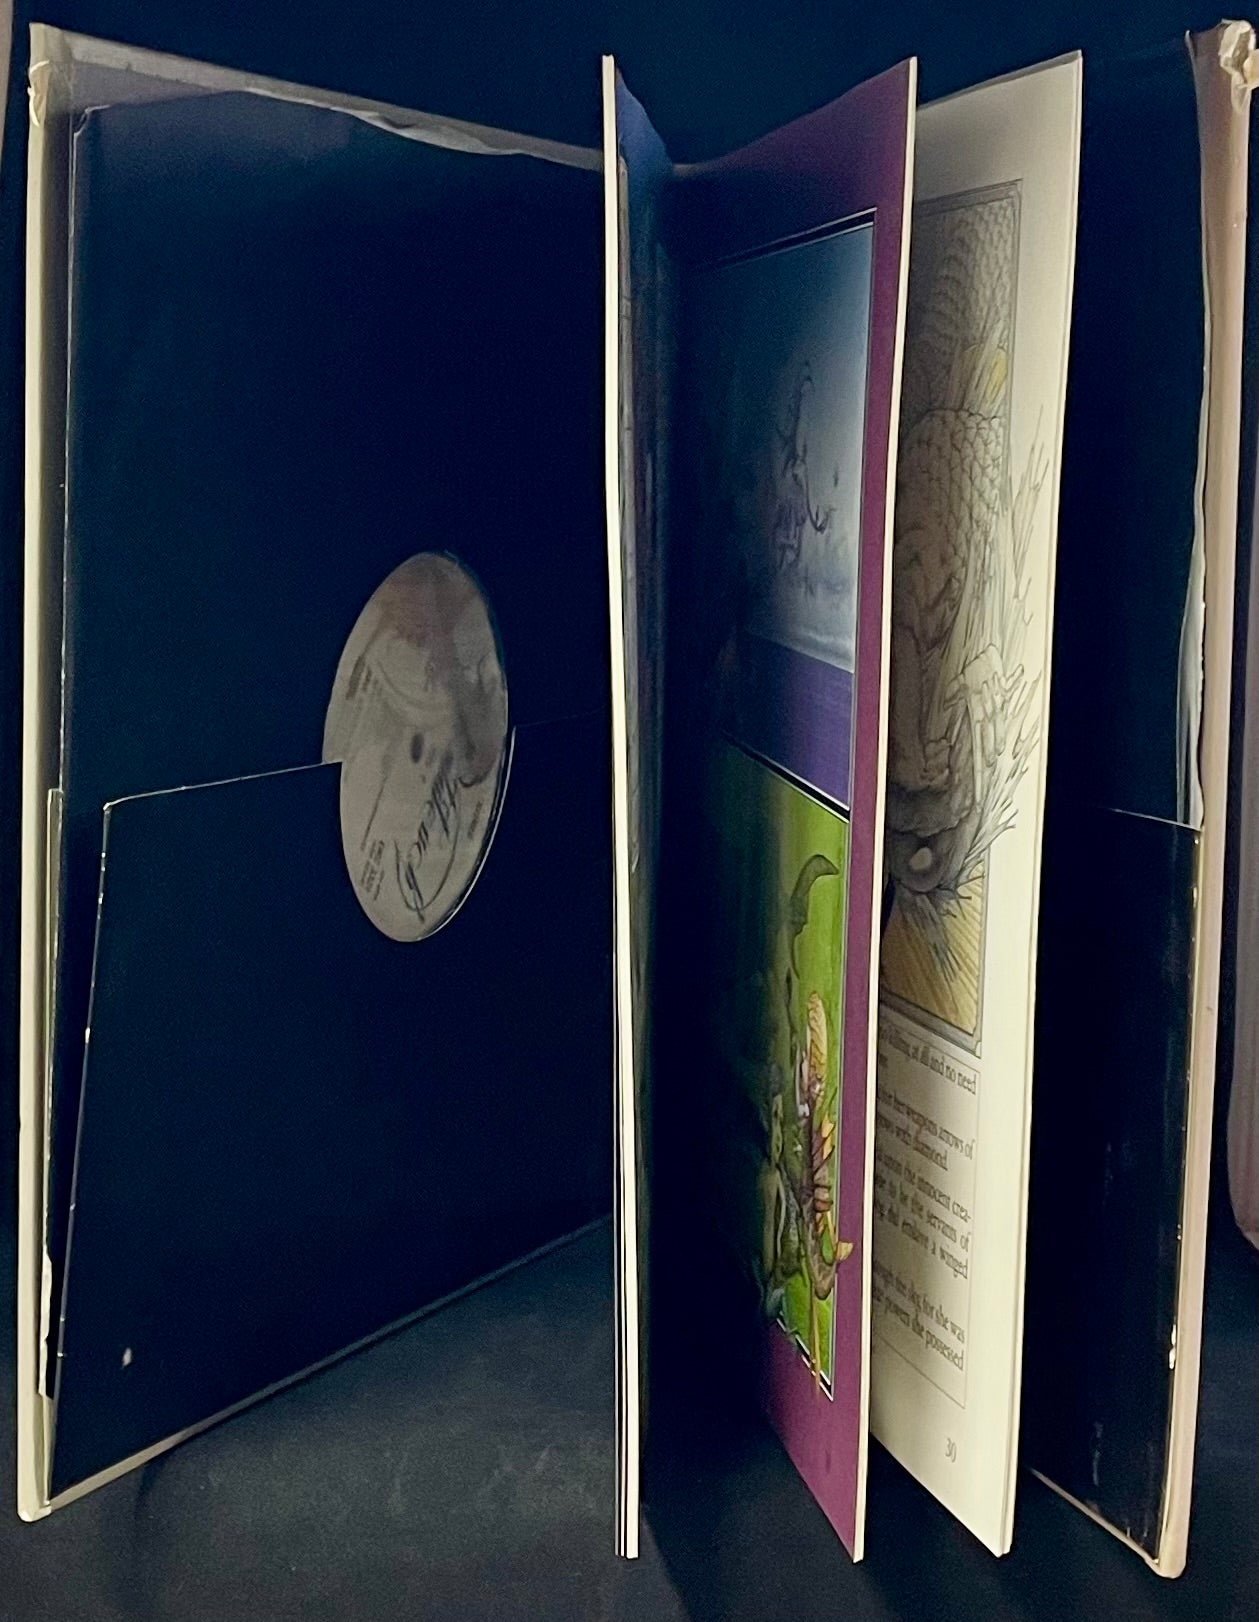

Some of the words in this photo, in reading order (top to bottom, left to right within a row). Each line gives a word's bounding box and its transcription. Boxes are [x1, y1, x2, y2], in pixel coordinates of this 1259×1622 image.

[930, 1055, 943, 1075] and
[945, 1065, 956, 1083] no
[957, 1072, 976, 1094] need
[938, 1126, 963, 1152] arrows
[964, 1139, 974, 1161] of
[917, 1175, 950, 1211] innocent
[952, 1200, 971, 1225] crea-
[926, 1209, 957, 1242] servants
[959, 1231, 970, 1253] of
[939, 1245, 967, 1279] winged
[935, 1307, 948, 1330] she
[949, 1320, 964, 1343] was
[925, 1329, 963, 1371] possessed
[945, 1437, 957, 1463] 30
